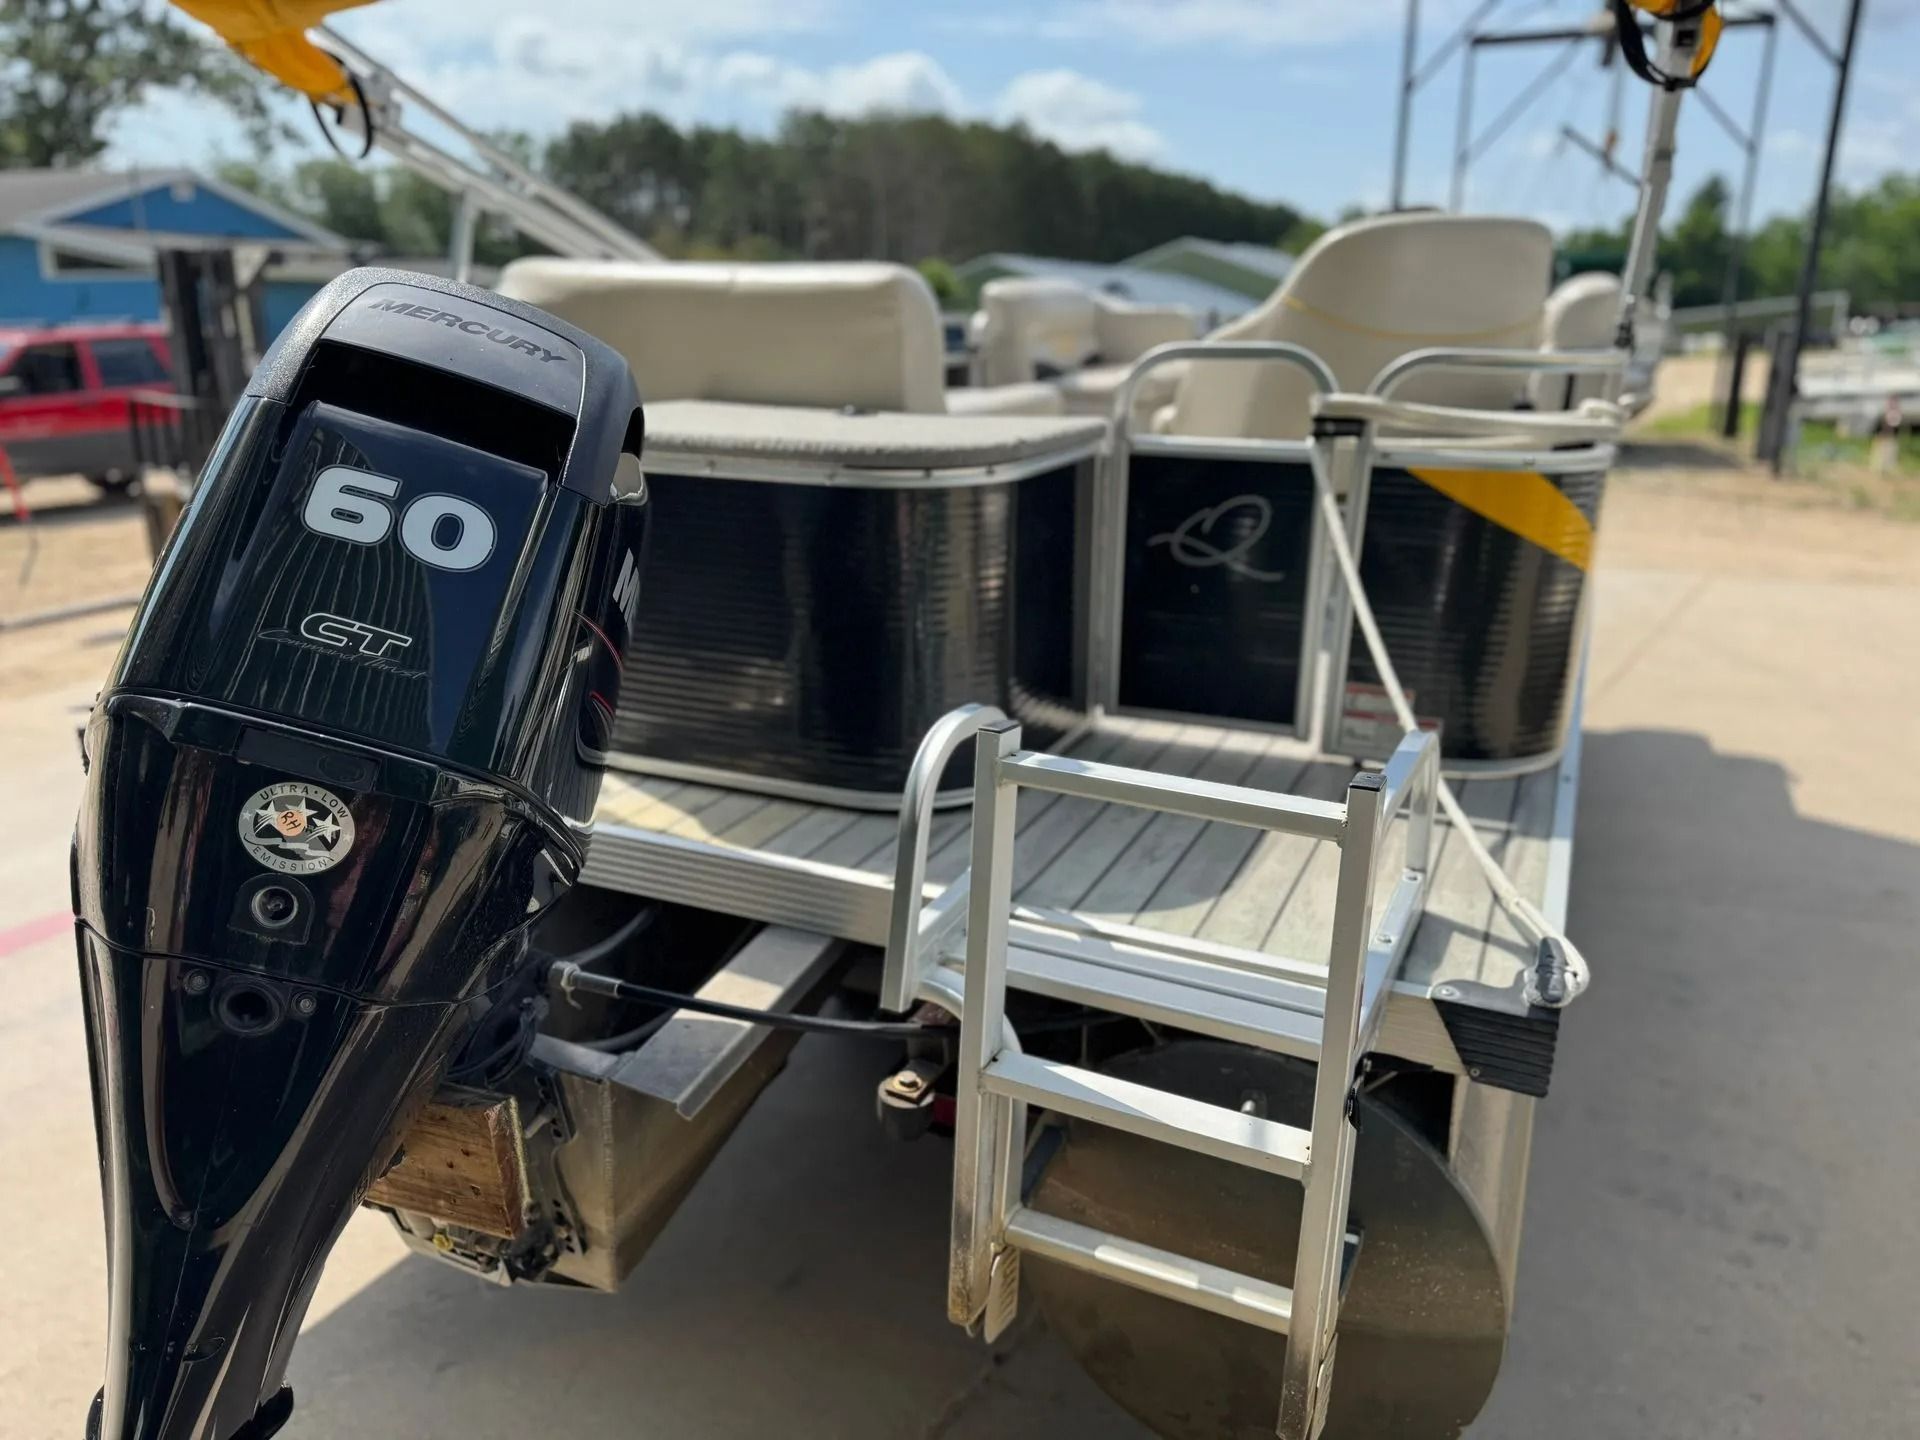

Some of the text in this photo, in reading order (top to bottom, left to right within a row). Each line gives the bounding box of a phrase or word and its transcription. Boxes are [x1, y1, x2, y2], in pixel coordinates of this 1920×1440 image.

[368, 299, 567, 363] MERCURY
[301, 465, 498, 573] 60
[259, 784, 349, 819] ULTRA LOW
[281, 811, 302, 832] RH
[252, 846, 328, 872] EMISSION
